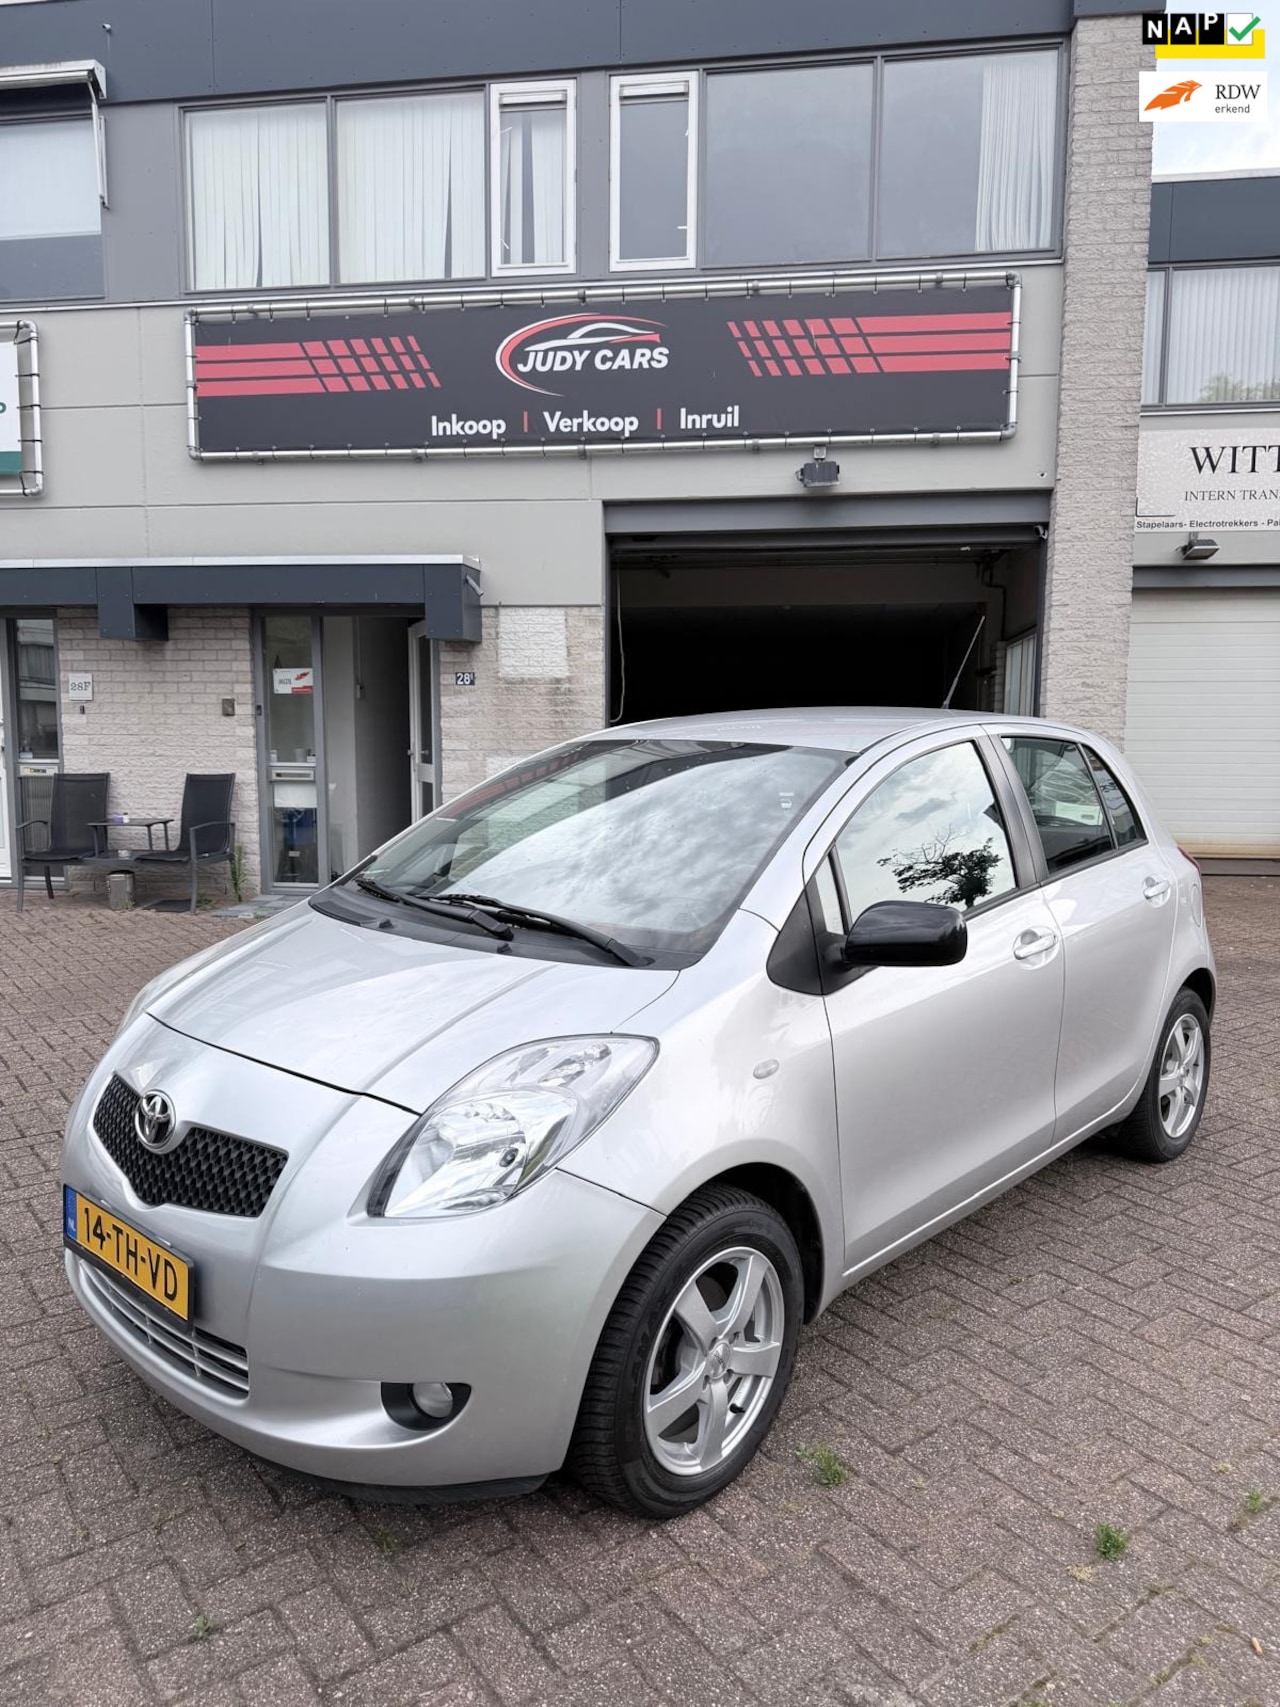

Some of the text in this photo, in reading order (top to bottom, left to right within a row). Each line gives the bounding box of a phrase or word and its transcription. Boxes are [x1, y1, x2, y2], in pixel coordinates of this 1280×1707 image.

[517, 347, 669, 372] JUDY CARS
[431, 405, 740, 439] Inkoop Verkoop Inruil
[1185, 489, 1280, 501] INTERN TRAN
[1189, 519, 1258, 528] Electrotrekkers
[1267, 519, 1280, 527] Pa
[70, 681, 91, 691] 28F
[68, 1217, 76, 1232] NL
[84, 1207, 178, 1302] 14-TH-VD
